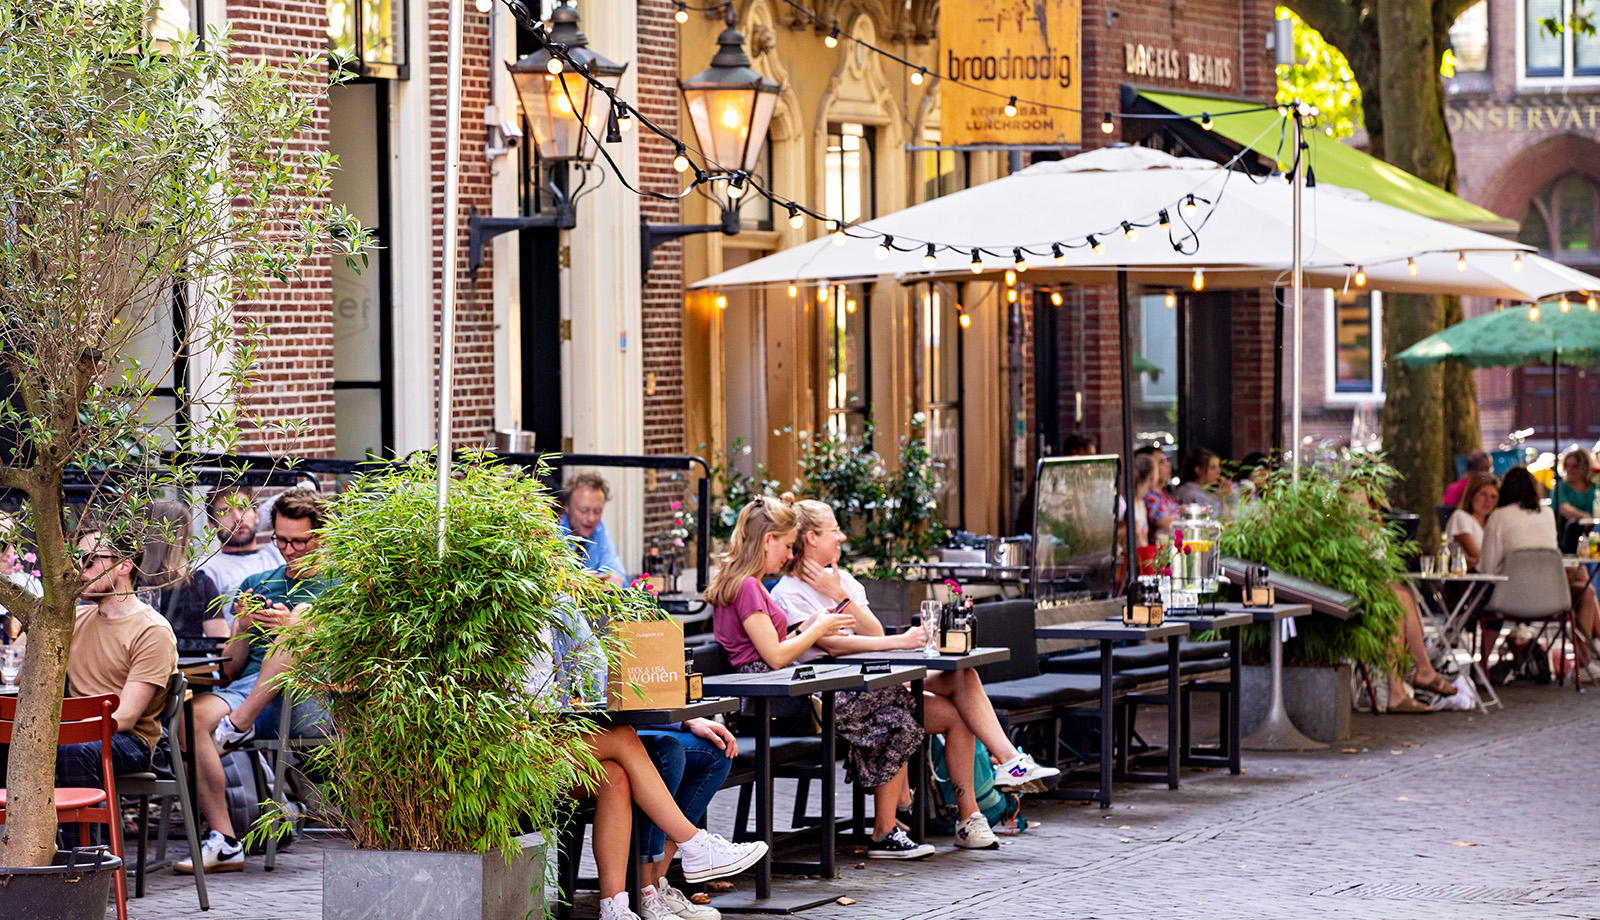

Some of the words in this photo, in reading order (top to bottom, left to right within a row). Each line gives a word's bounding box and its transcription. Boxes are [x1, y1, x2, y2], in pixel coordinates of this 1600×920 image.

[949, 48, 1071, 88] broodnodig
[1124, 43, 1180, 80] BAGELS
[1188, 52, 1231, 88] BEANS
[966, 119, 1054, 130] LUNCHROOM
[628, 671, 678, 683] wonen
